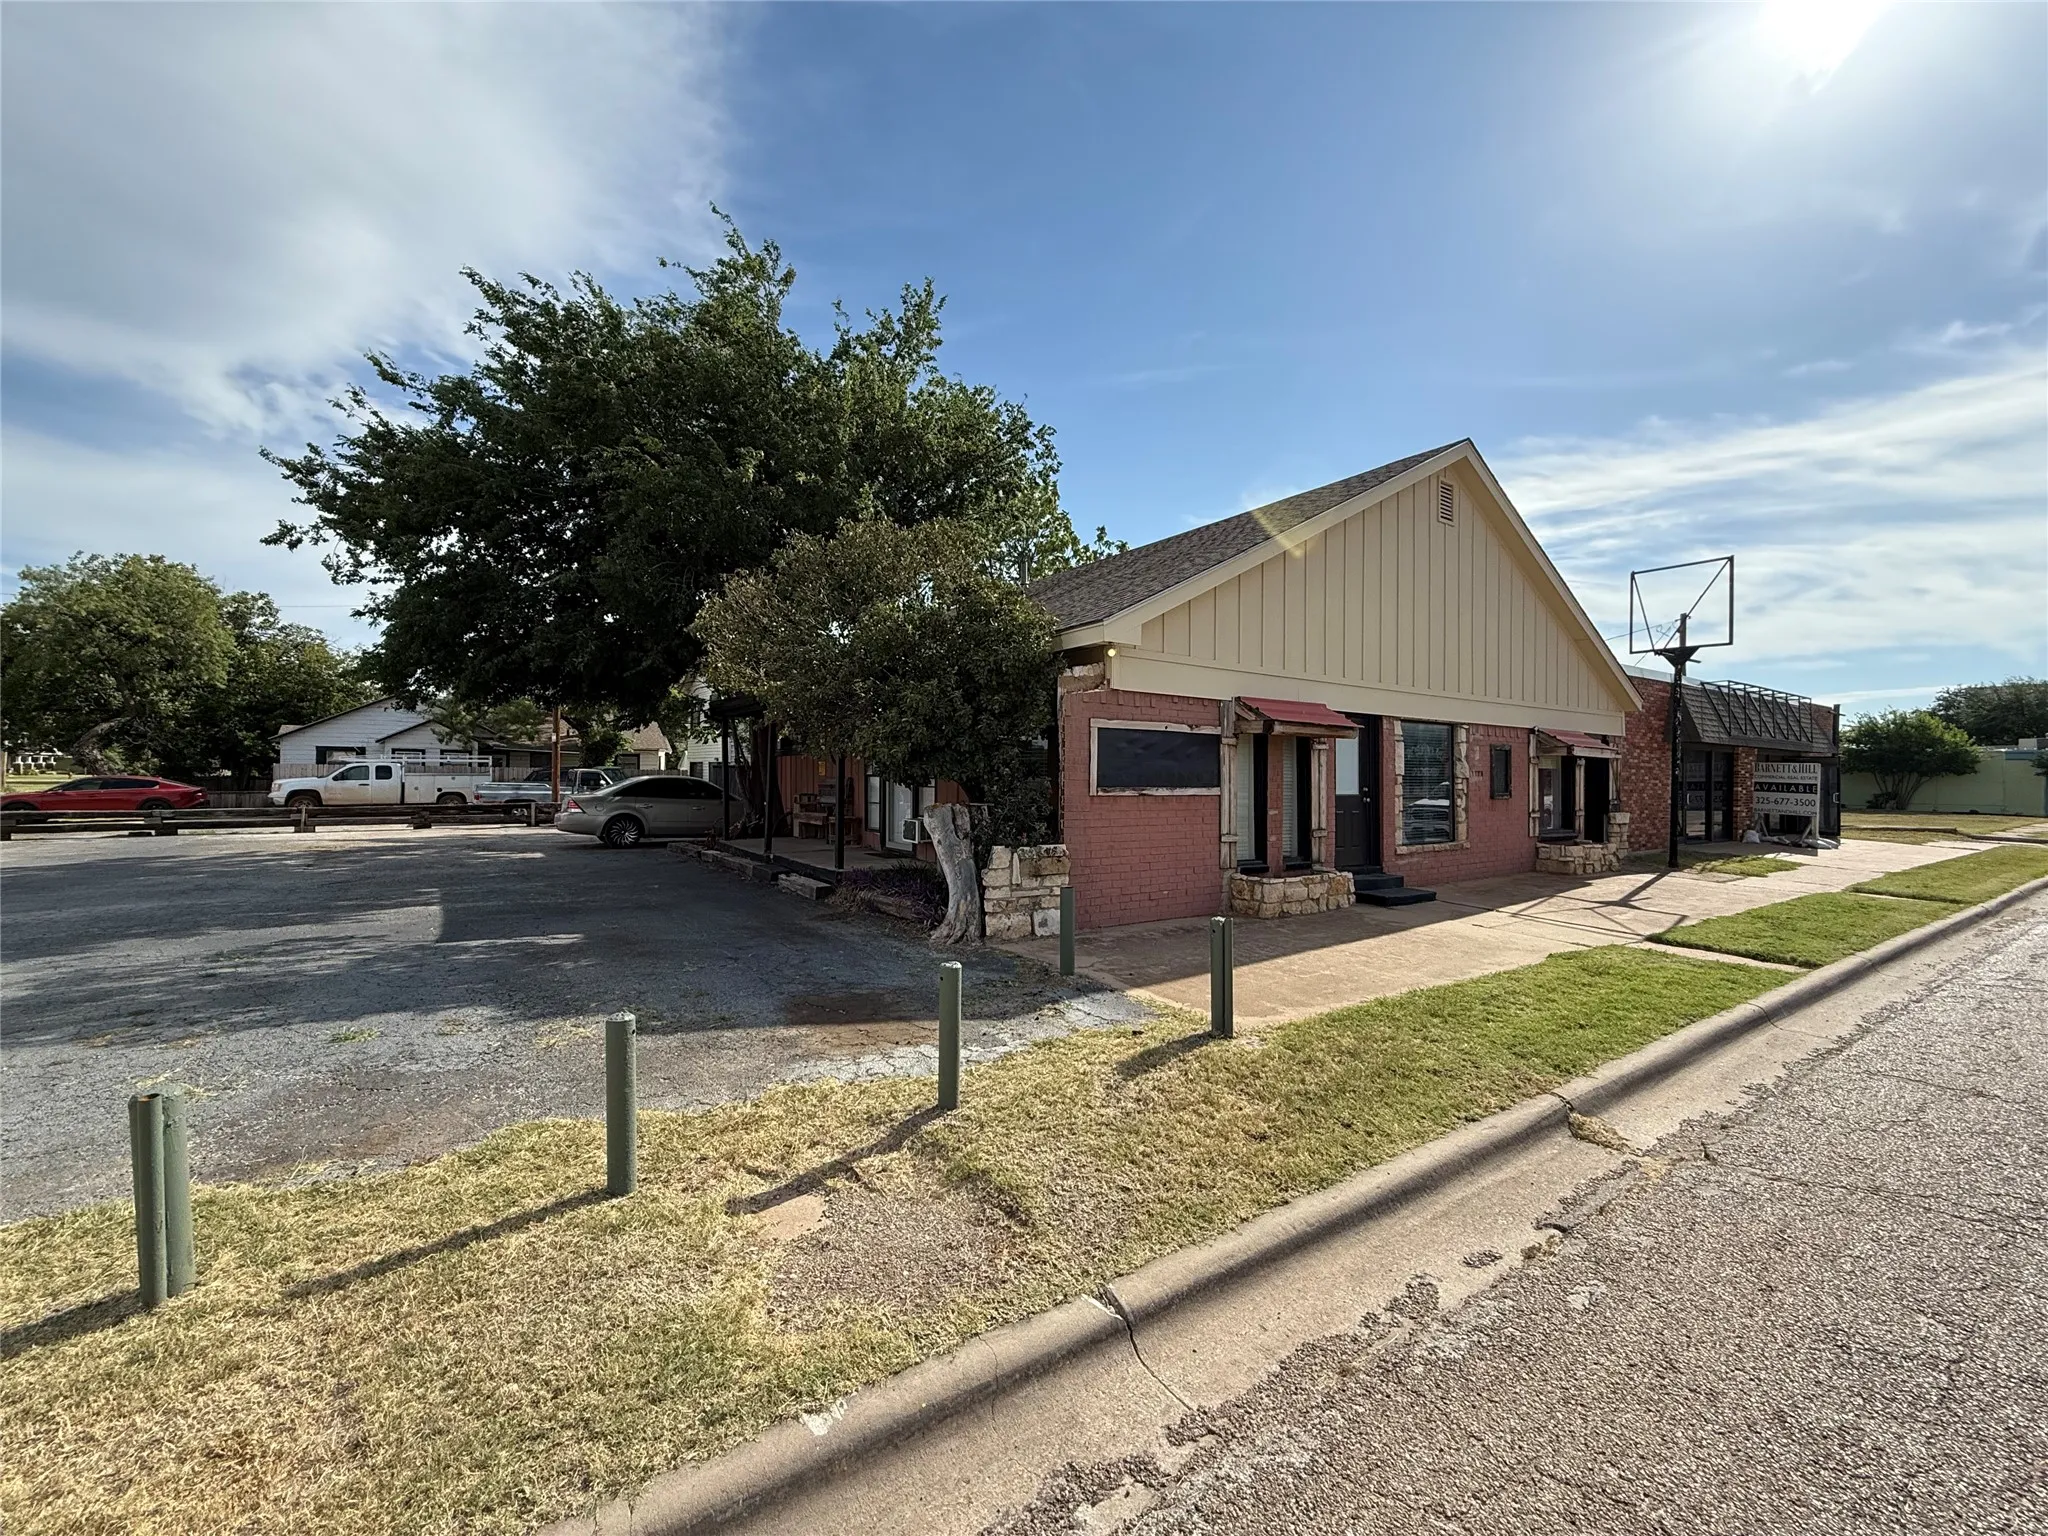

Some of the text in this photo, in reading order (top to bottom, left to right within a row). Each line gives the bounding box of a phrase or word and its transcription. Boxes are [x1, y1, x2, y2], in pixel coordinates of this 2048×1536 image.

[1754, 763, 1818, 774] BARNETT&HILL
[1754, 783, 1818, 793] AVAILABLE
[1755, 796, 1816, 807] 325-677-3500
